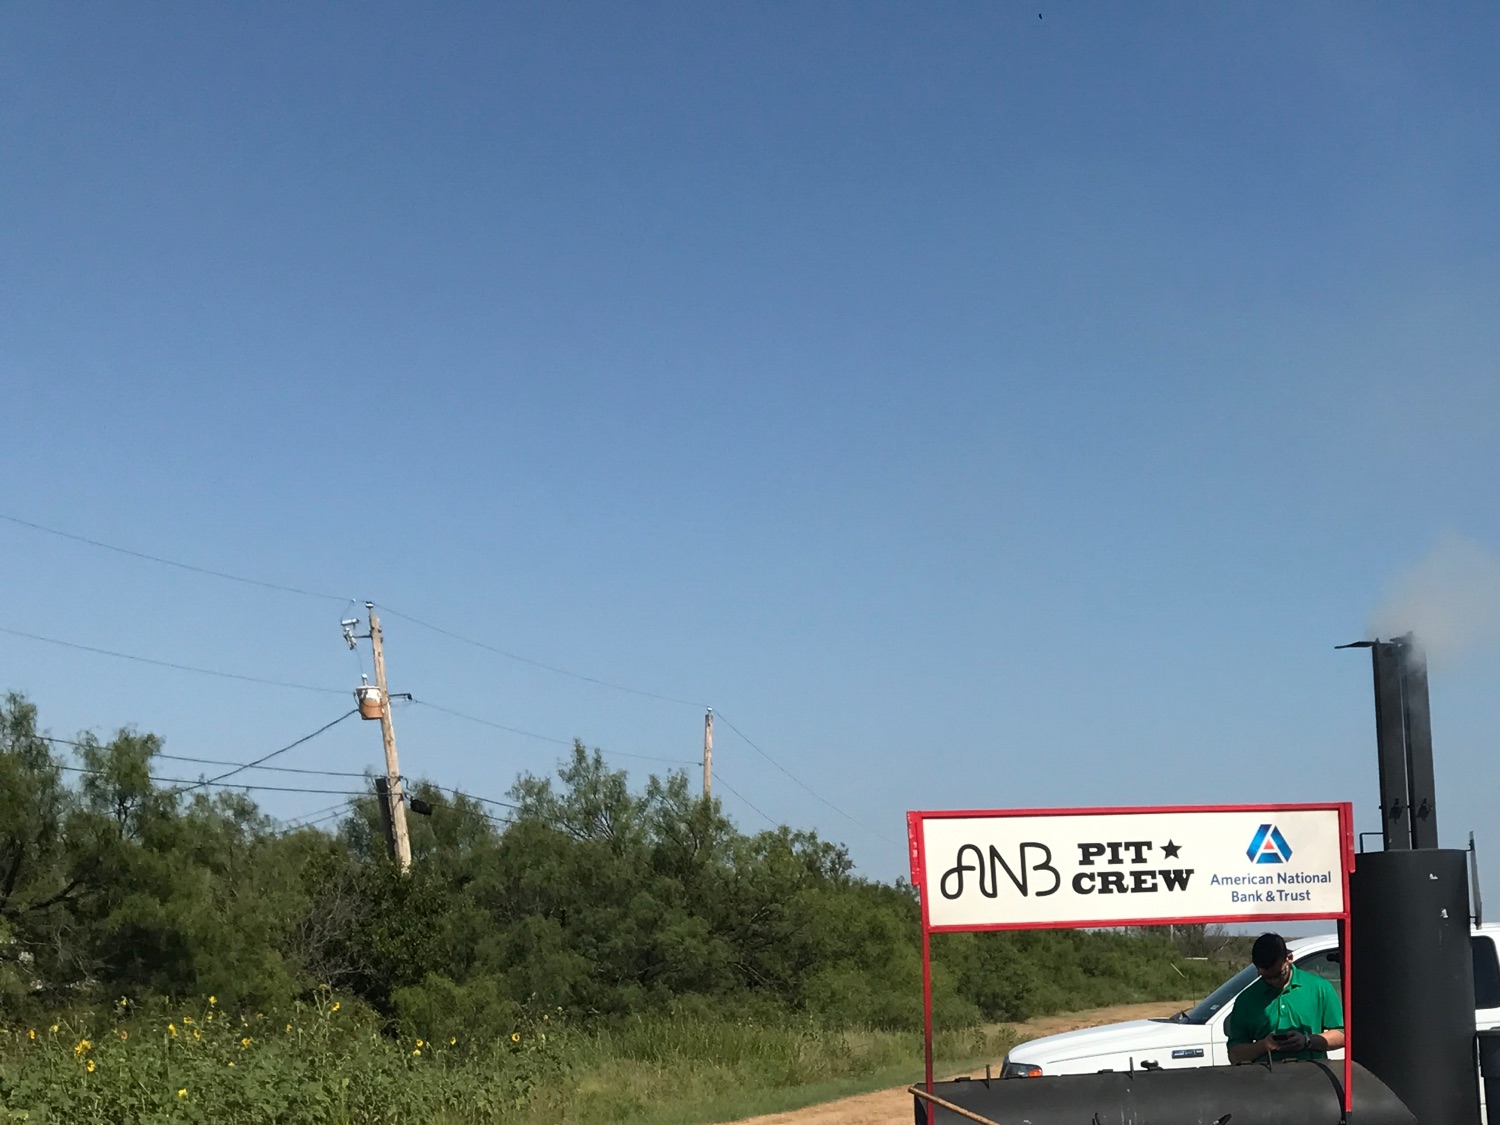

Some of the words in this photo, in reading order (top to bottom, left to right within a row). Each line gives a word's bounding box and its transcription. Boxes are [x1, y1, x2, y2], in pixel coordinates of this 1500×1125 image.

[1077, 840, 1153, 866] PIT
[940, 842, 1061, 900] ANB
[1071, 868, 1195, 895] CREW
[1210, 873, 1274, 886] American
[1277, 870, 1332, 885] National
[1231, 889, 1263, 903] Bank
[1265, 890, 1275, 902] &
[1276, 889, 1311, 902] Trust
